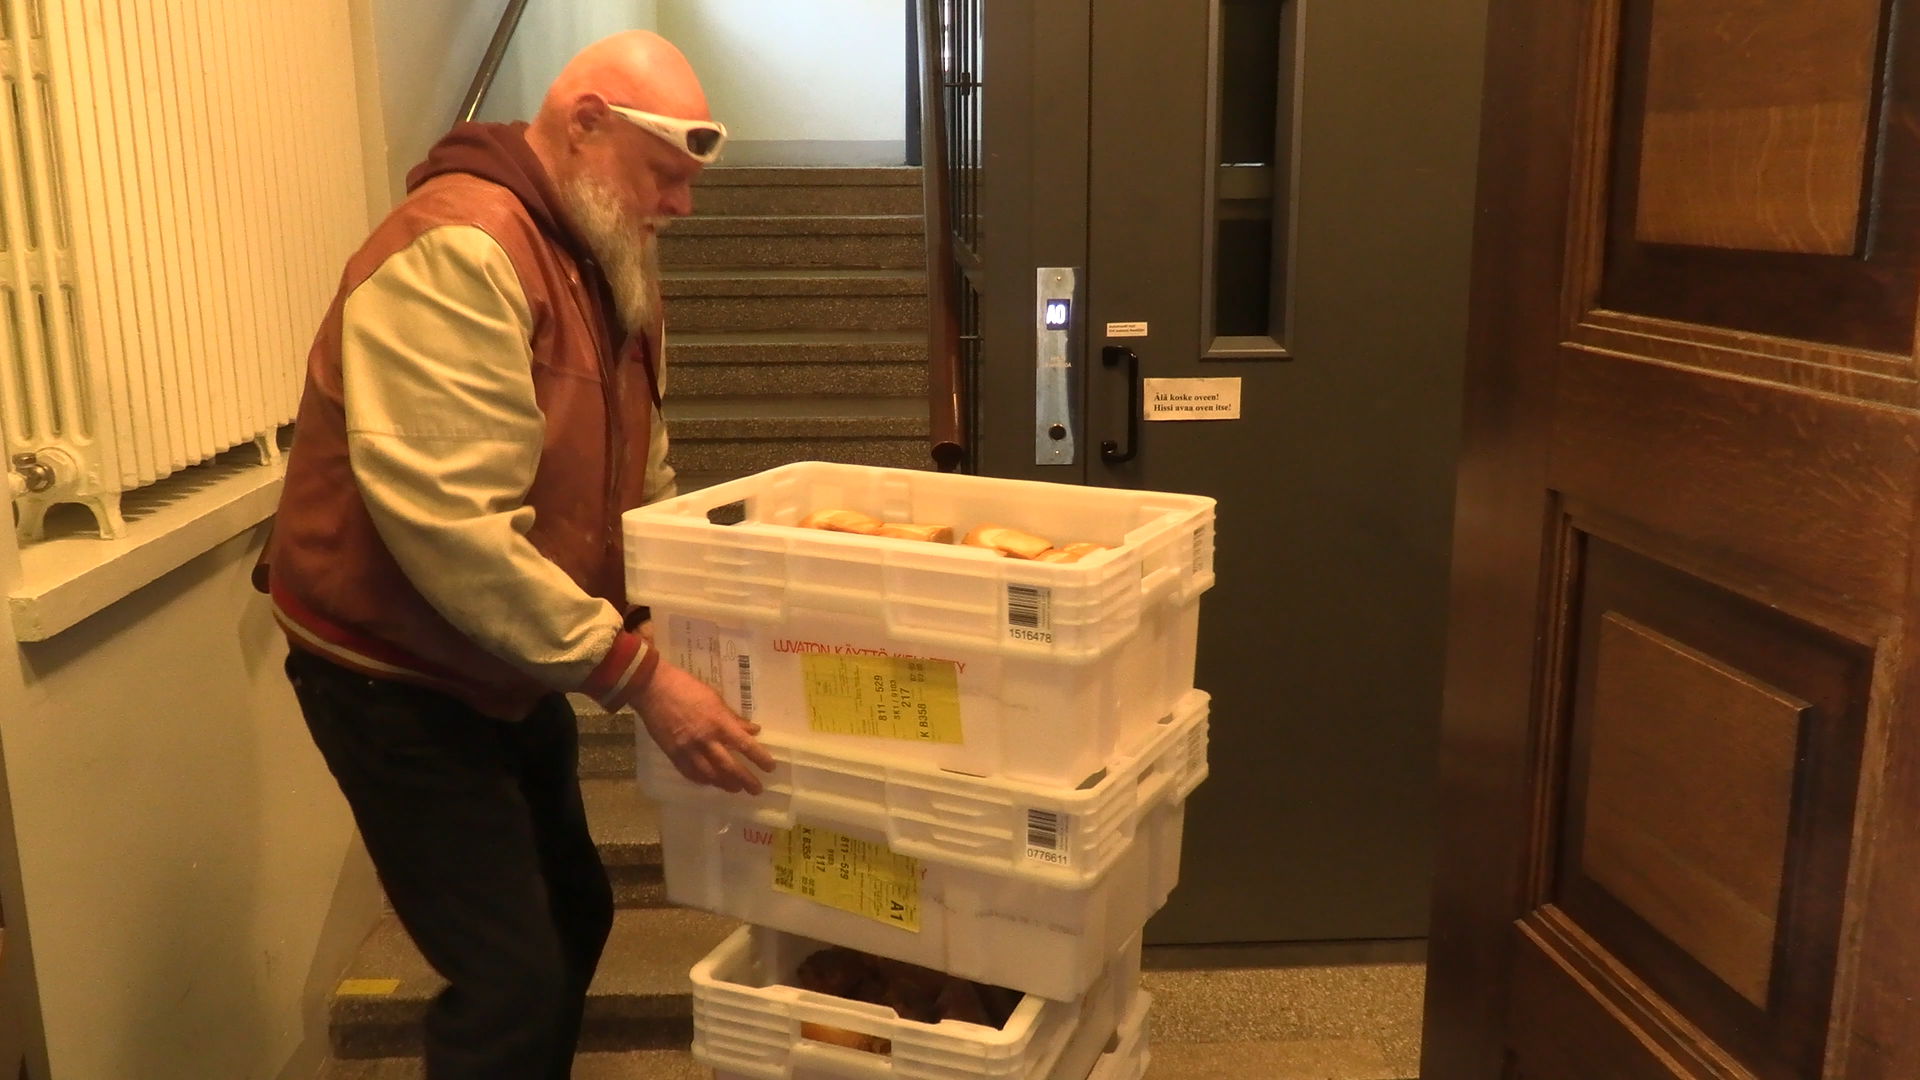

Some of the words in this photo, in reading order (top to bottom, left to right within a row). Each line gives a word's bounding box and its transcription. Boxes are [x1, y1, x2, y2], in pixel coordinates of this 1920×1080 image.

[1154, 392, 1168, 401] Älä
[1194, 393, 1219, 401] oveen!
[1010, 628, 1052, 643] 1516478
[773, 640, 830, 655] LUVATON
[900, 688, 911, 708] 217
[917, 703, 928, 728] B358
[816, 855, 825, 873] 117
[1027, 848, 1067, 865] 0776611
[890, 900, 904, 921] A1
